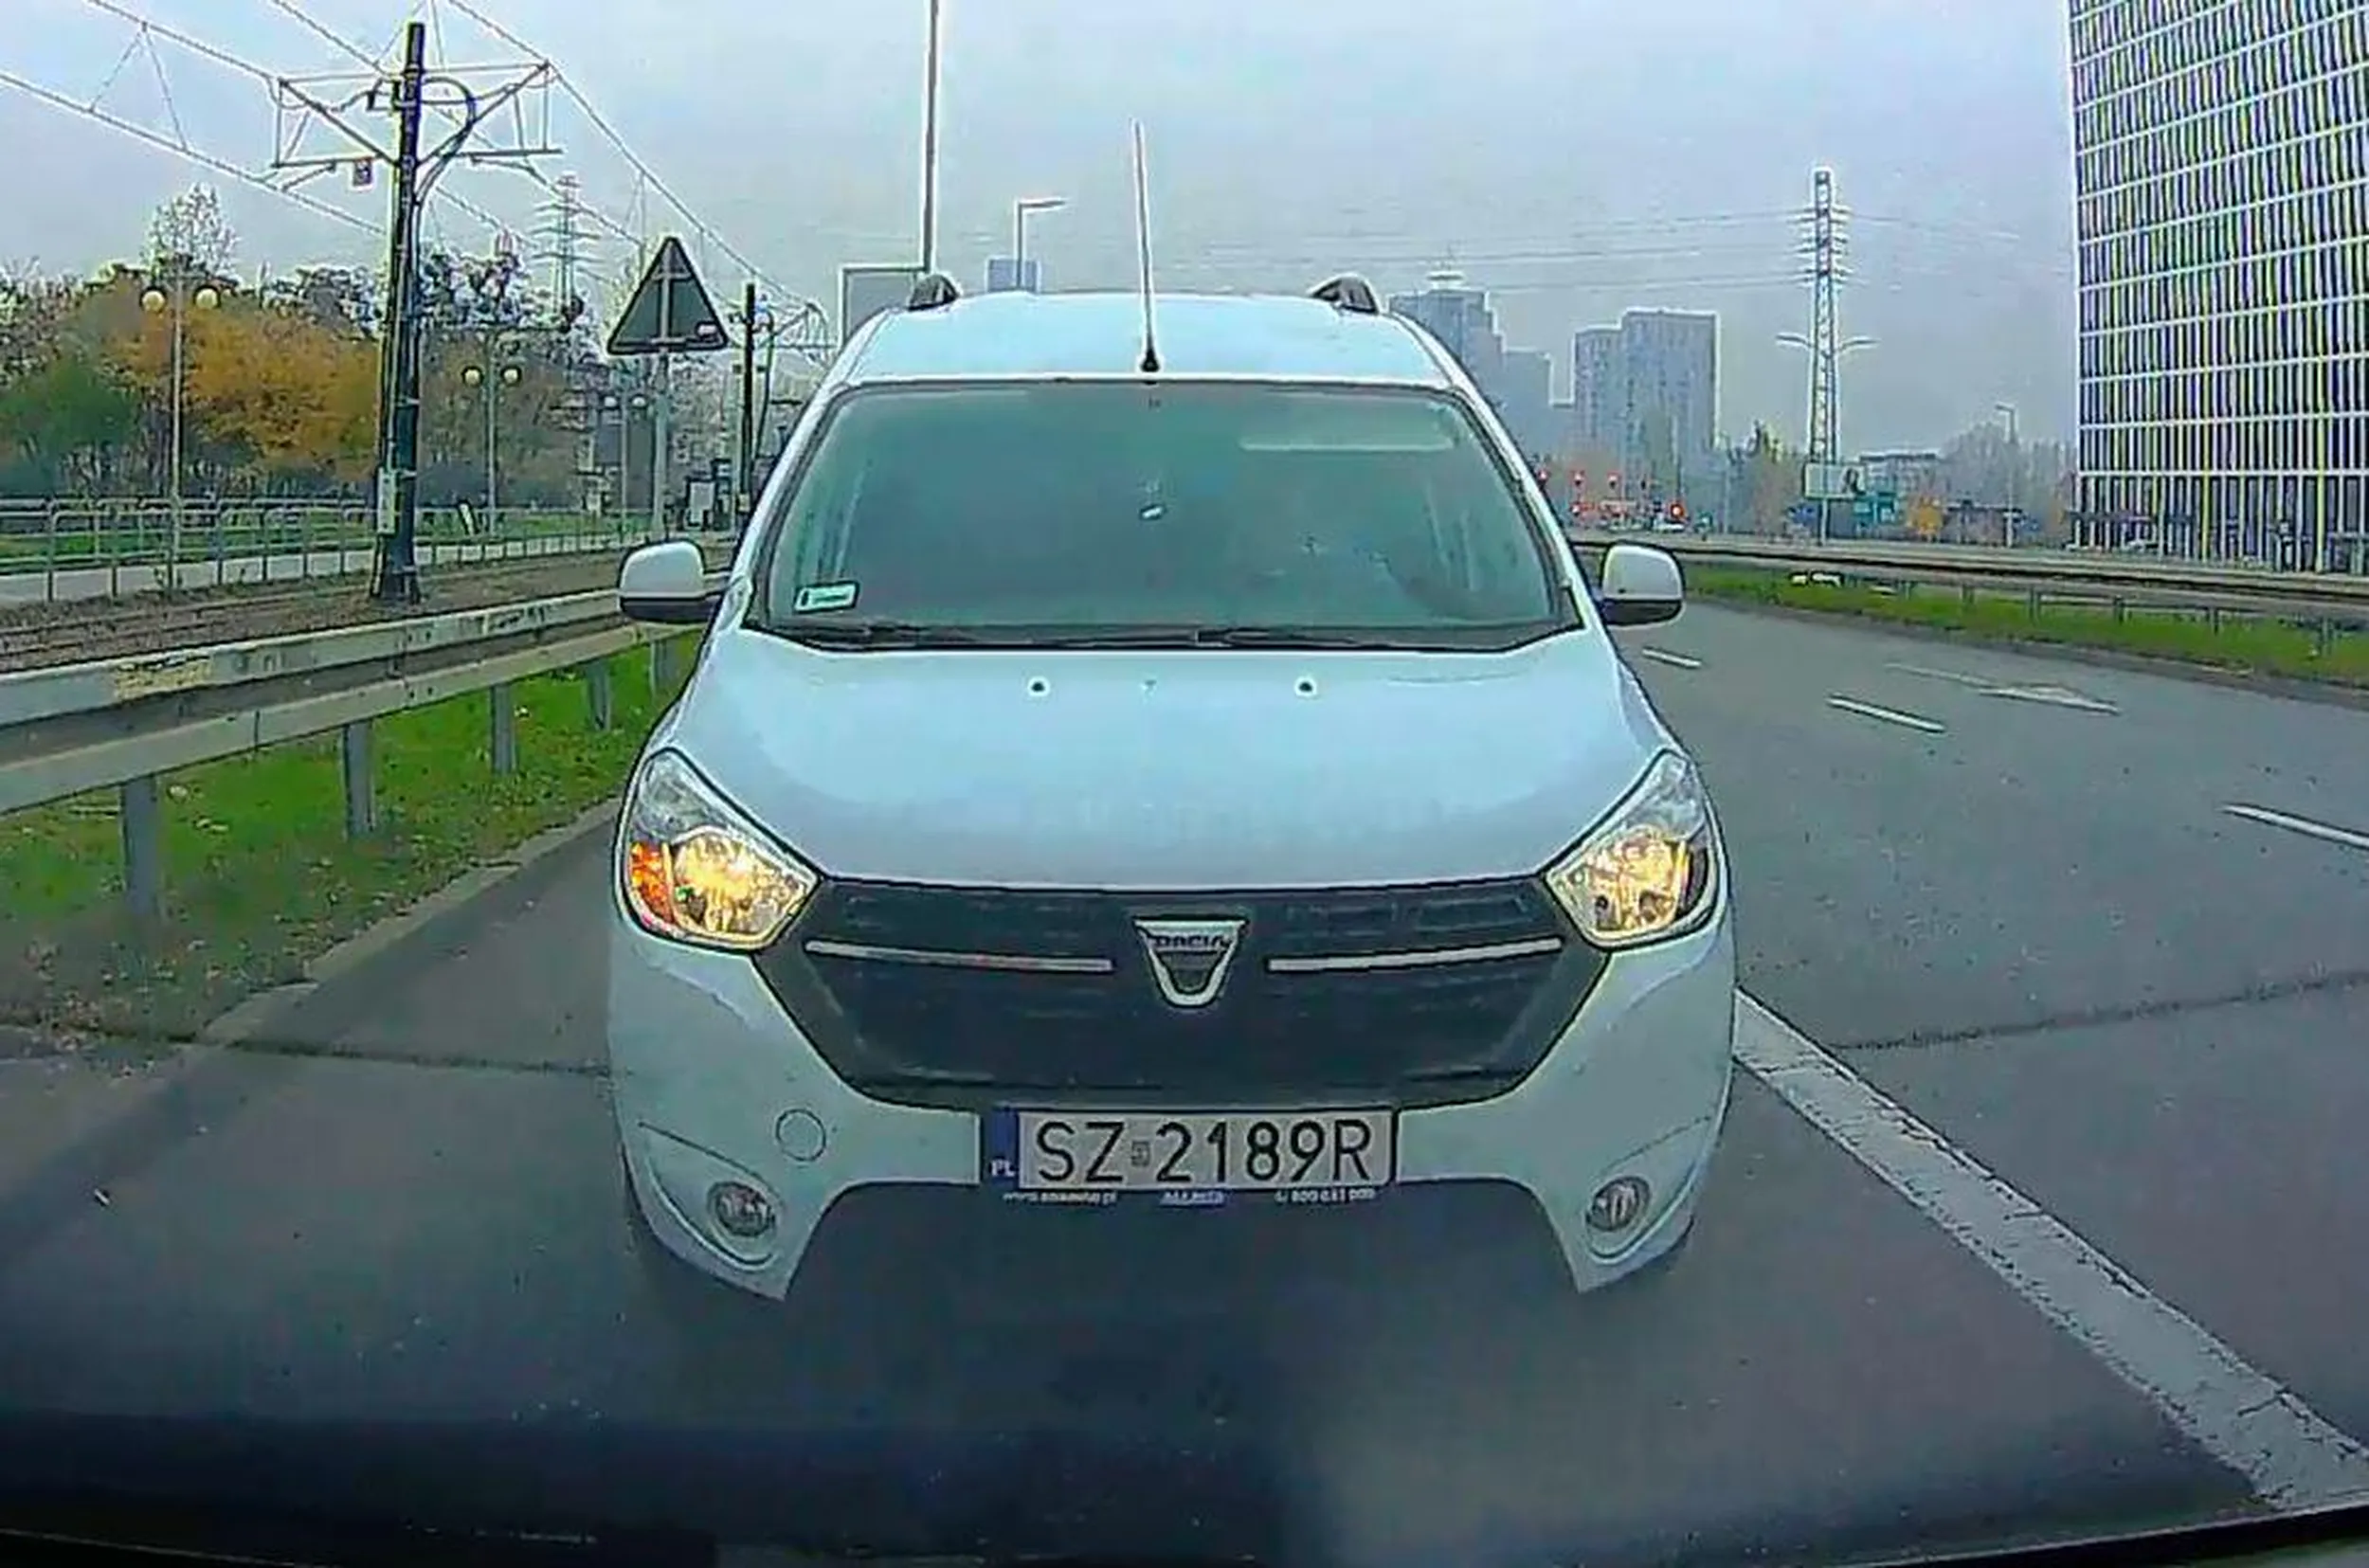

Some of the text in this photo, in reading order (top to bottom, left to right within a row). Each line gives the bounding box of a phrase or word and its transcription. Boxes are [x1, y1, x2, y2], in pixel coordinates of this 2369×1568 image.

[1152, 934, 1233, 948] DACIA
[1036, 1119, 1372, 1182] SZ 2189R
[991, 1161, 1015, 1177] PL
